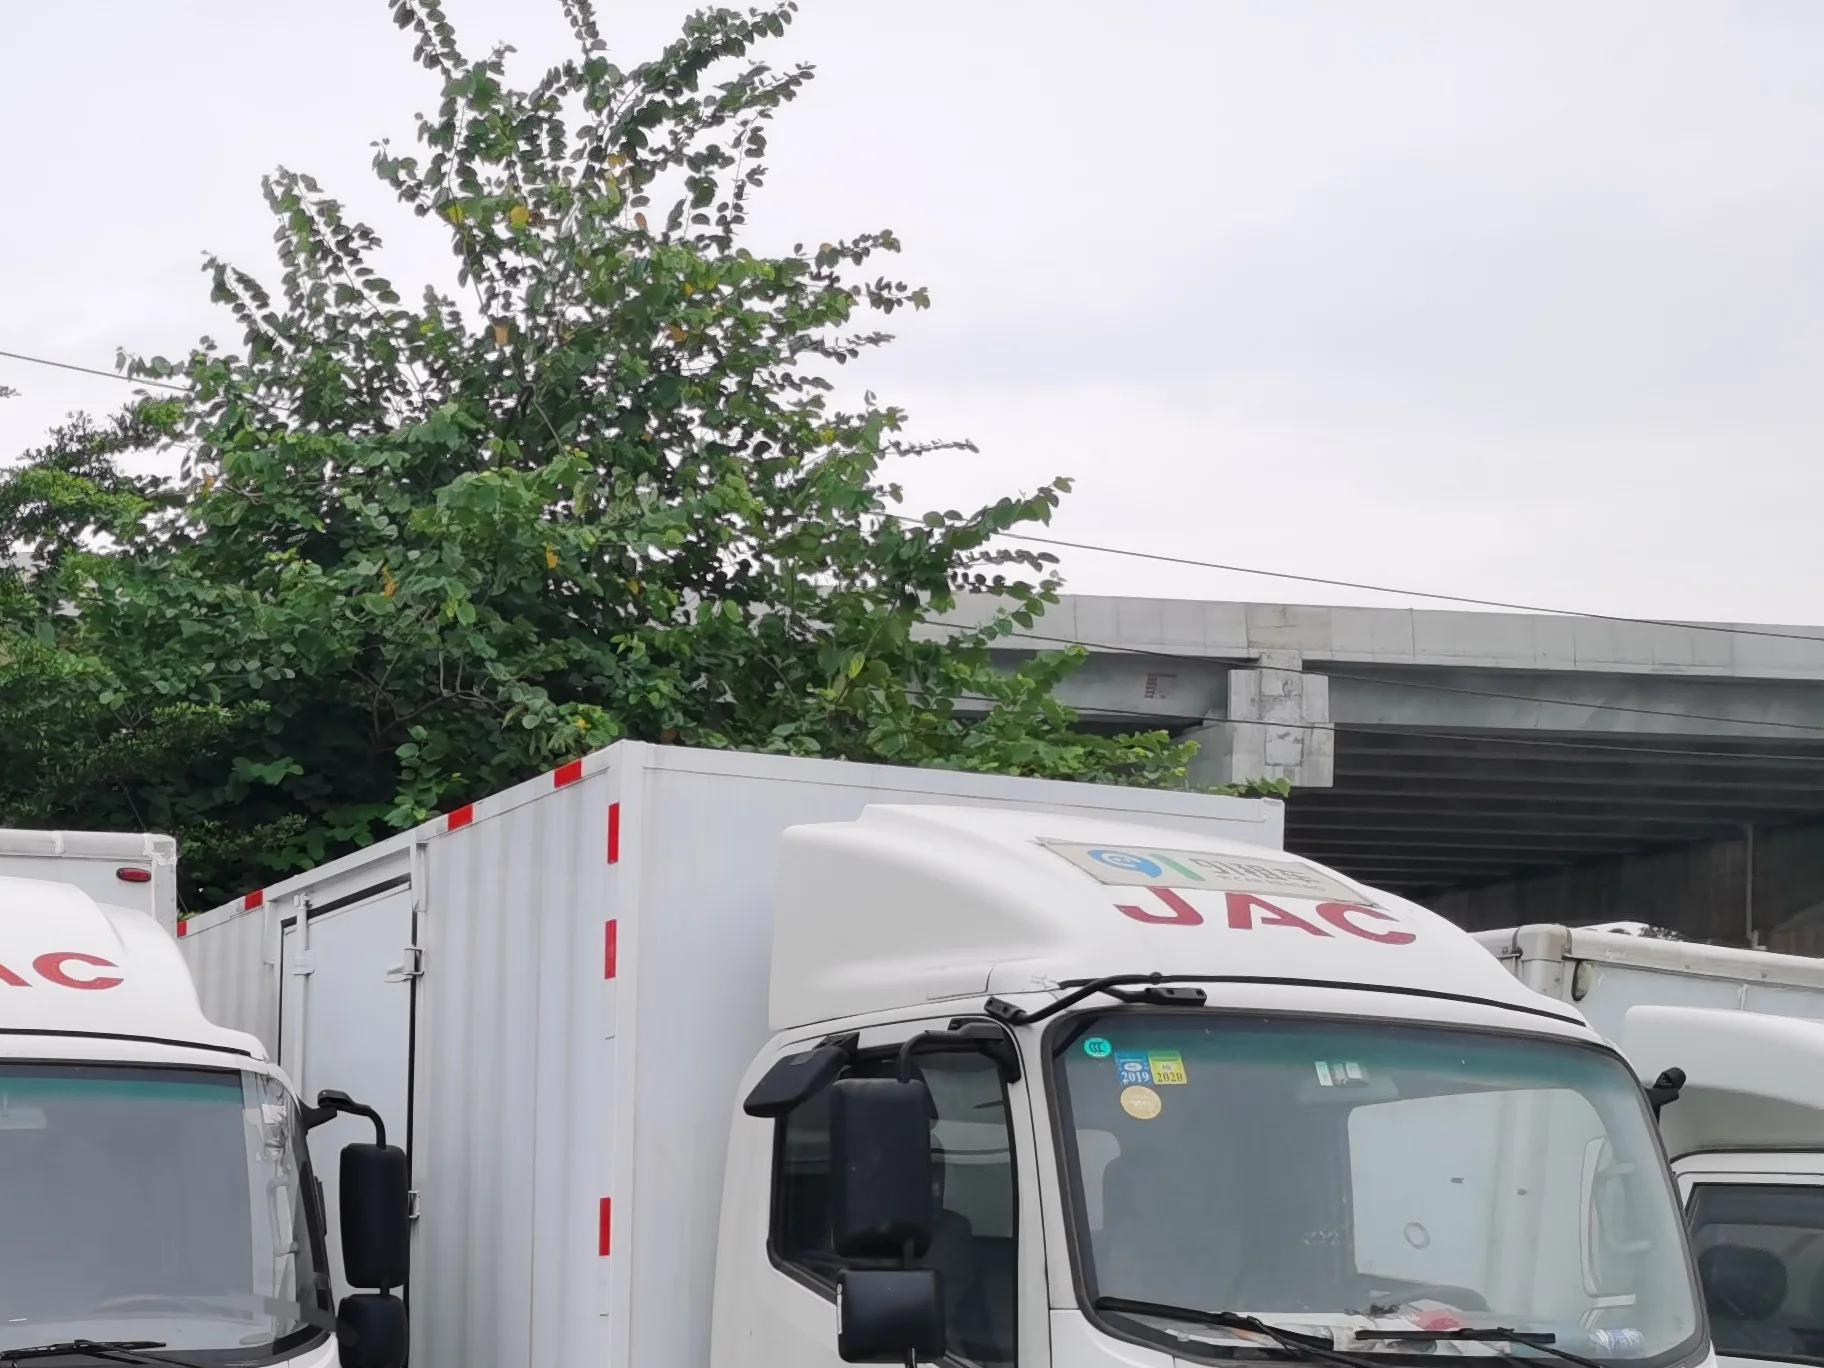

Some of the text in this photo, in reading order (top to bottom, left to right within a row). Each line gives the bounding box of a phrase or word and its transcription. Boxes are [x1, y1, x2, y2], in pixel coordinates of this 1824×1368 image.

[1113, 886, 1417, 945] JAC
[1121, 1071, 1150, 1083] 2019
[1156, 1072, 1183, 1083] 2020
